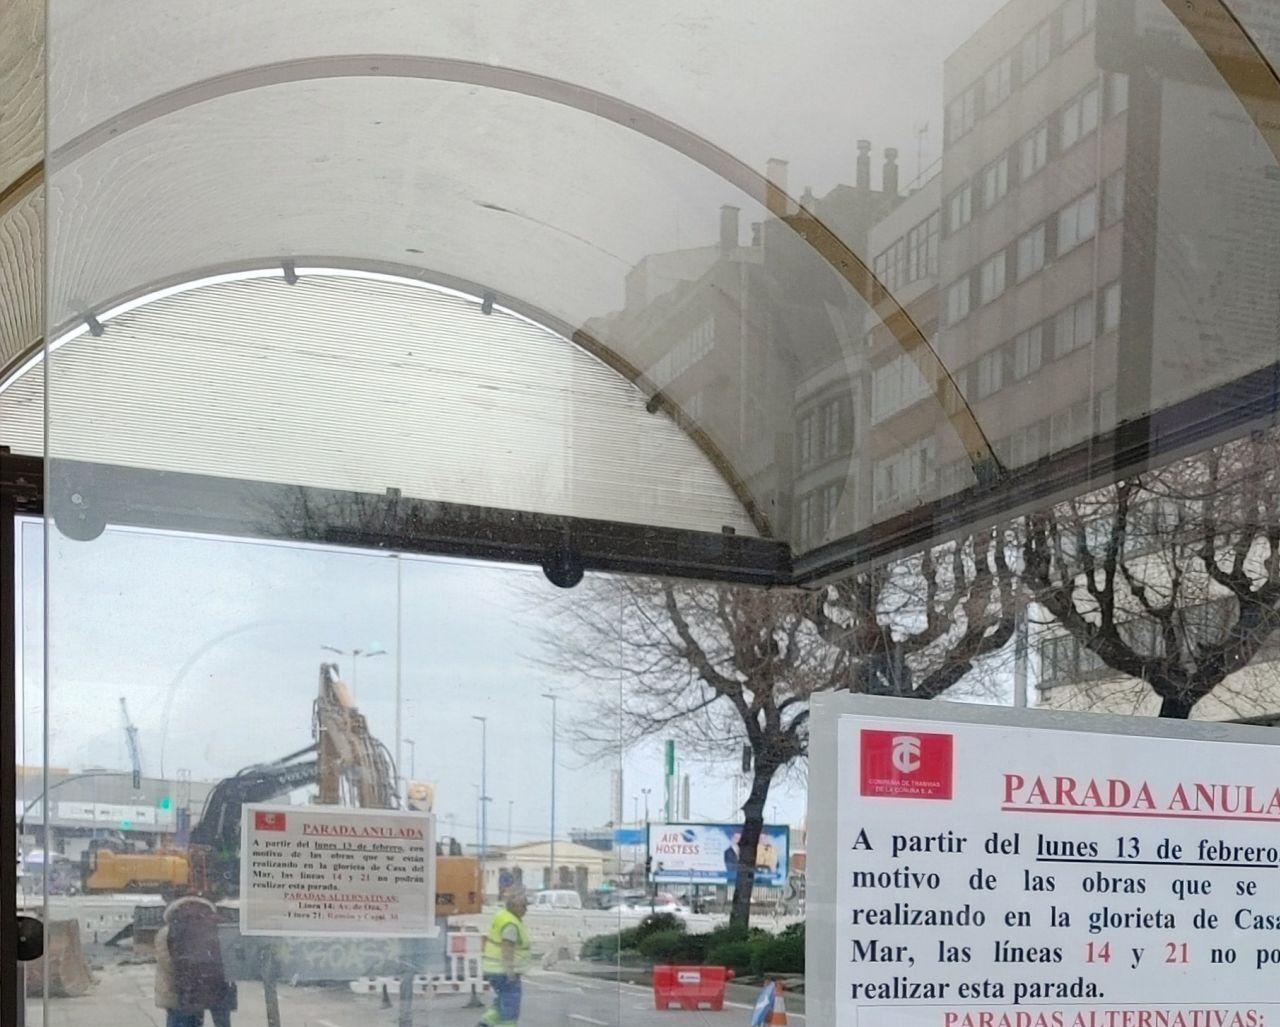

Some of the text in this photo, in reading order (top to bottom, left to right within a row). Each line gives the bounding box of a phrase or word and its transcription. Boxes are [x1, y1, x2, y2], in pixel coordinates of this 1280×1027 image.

[1002, 773, 1157, 811] PARADA
[656, 844, 700, 855] HOSTESS
[662, 833, 679, 843] AIR
[852, 828, 873, 850] A
[892, 831, 967, 857] partir
[985, 832, 1019, 854] del
[1037, 834, 1099, 858] lunes
[1115, 838, 1142, 860] 13
[1156, 838, 1183, 861] de
[853, 866, 940, 889] motivo
[969, 868, 996, 890] de
[1024, 870, 1055, 891] las
[1083, 872, 1145, 893] obras
[1172, 879, 1211, 900] que
[1236, 881, 1256, 895] se
[853, 903, 985, 926] realizando
[1005, 911, 1031, 927] en
[1051, 906, 1070, 927] la
[1089, 907, 1175, 934] glorieta
[1193, 908, 1218, 929] de
[852, 940, 914, 966] Mar,
[939, 941, 971, 962] las
[994, 940, 1062, 963] líneas
[1088, 942, 1110, 962] 14
[1132, 949, 1144, 969] y
[1166, 943, 1187, 962] 21
[1211, 949, 1236, 963] no
[852, 977, 1105, 1005] realizar esta parada.
